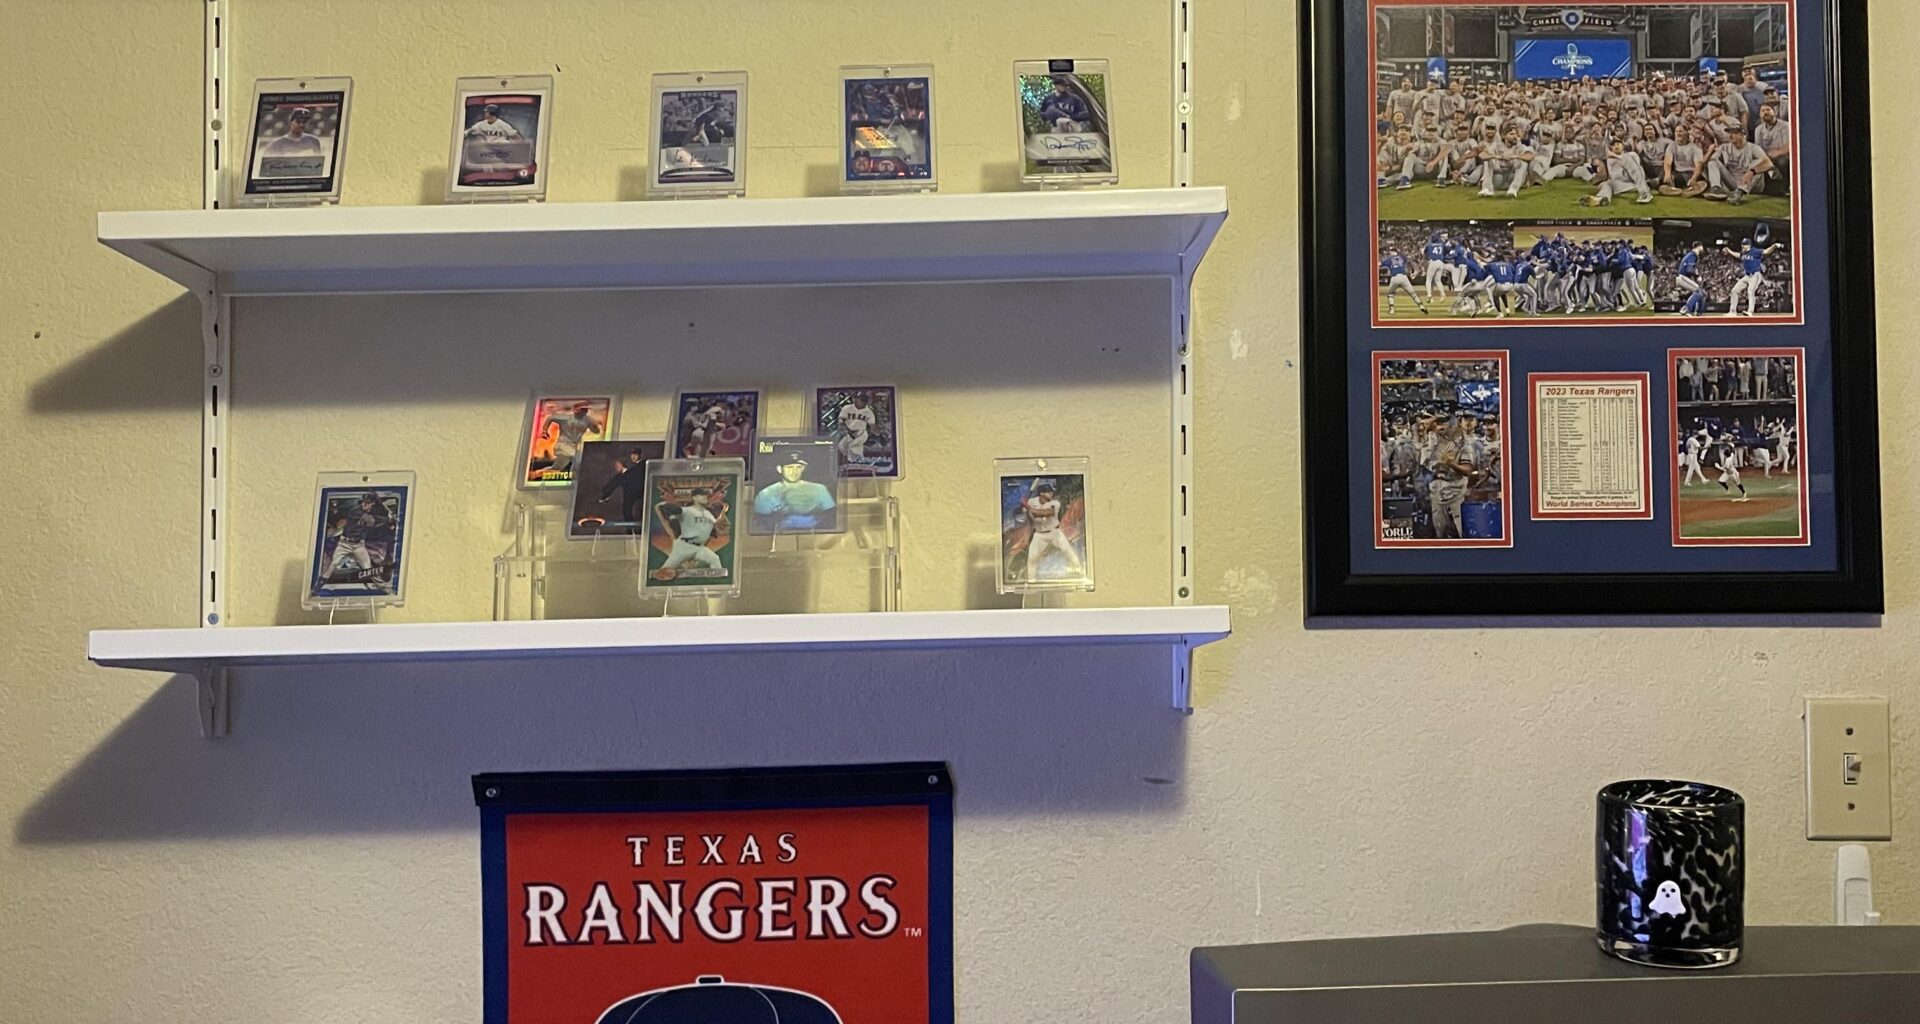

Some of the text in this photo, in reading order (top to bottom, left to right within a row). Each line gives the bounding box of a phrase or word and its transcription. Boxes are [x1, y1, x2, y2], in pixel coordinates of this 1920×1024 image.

[1532, 17, 1612, 26] CHASE FIELD
[1432, 246, 1443, 255] 47
[1499, 266, 1507, 276] 11
[1545, 387, 1635, 397] 2023 Texas Rangers
[1595, 499, 1637, 508] Champions
[627, 833, 798, 866] TEXAS
[523, 874, 922, 945] RANGERS TM
